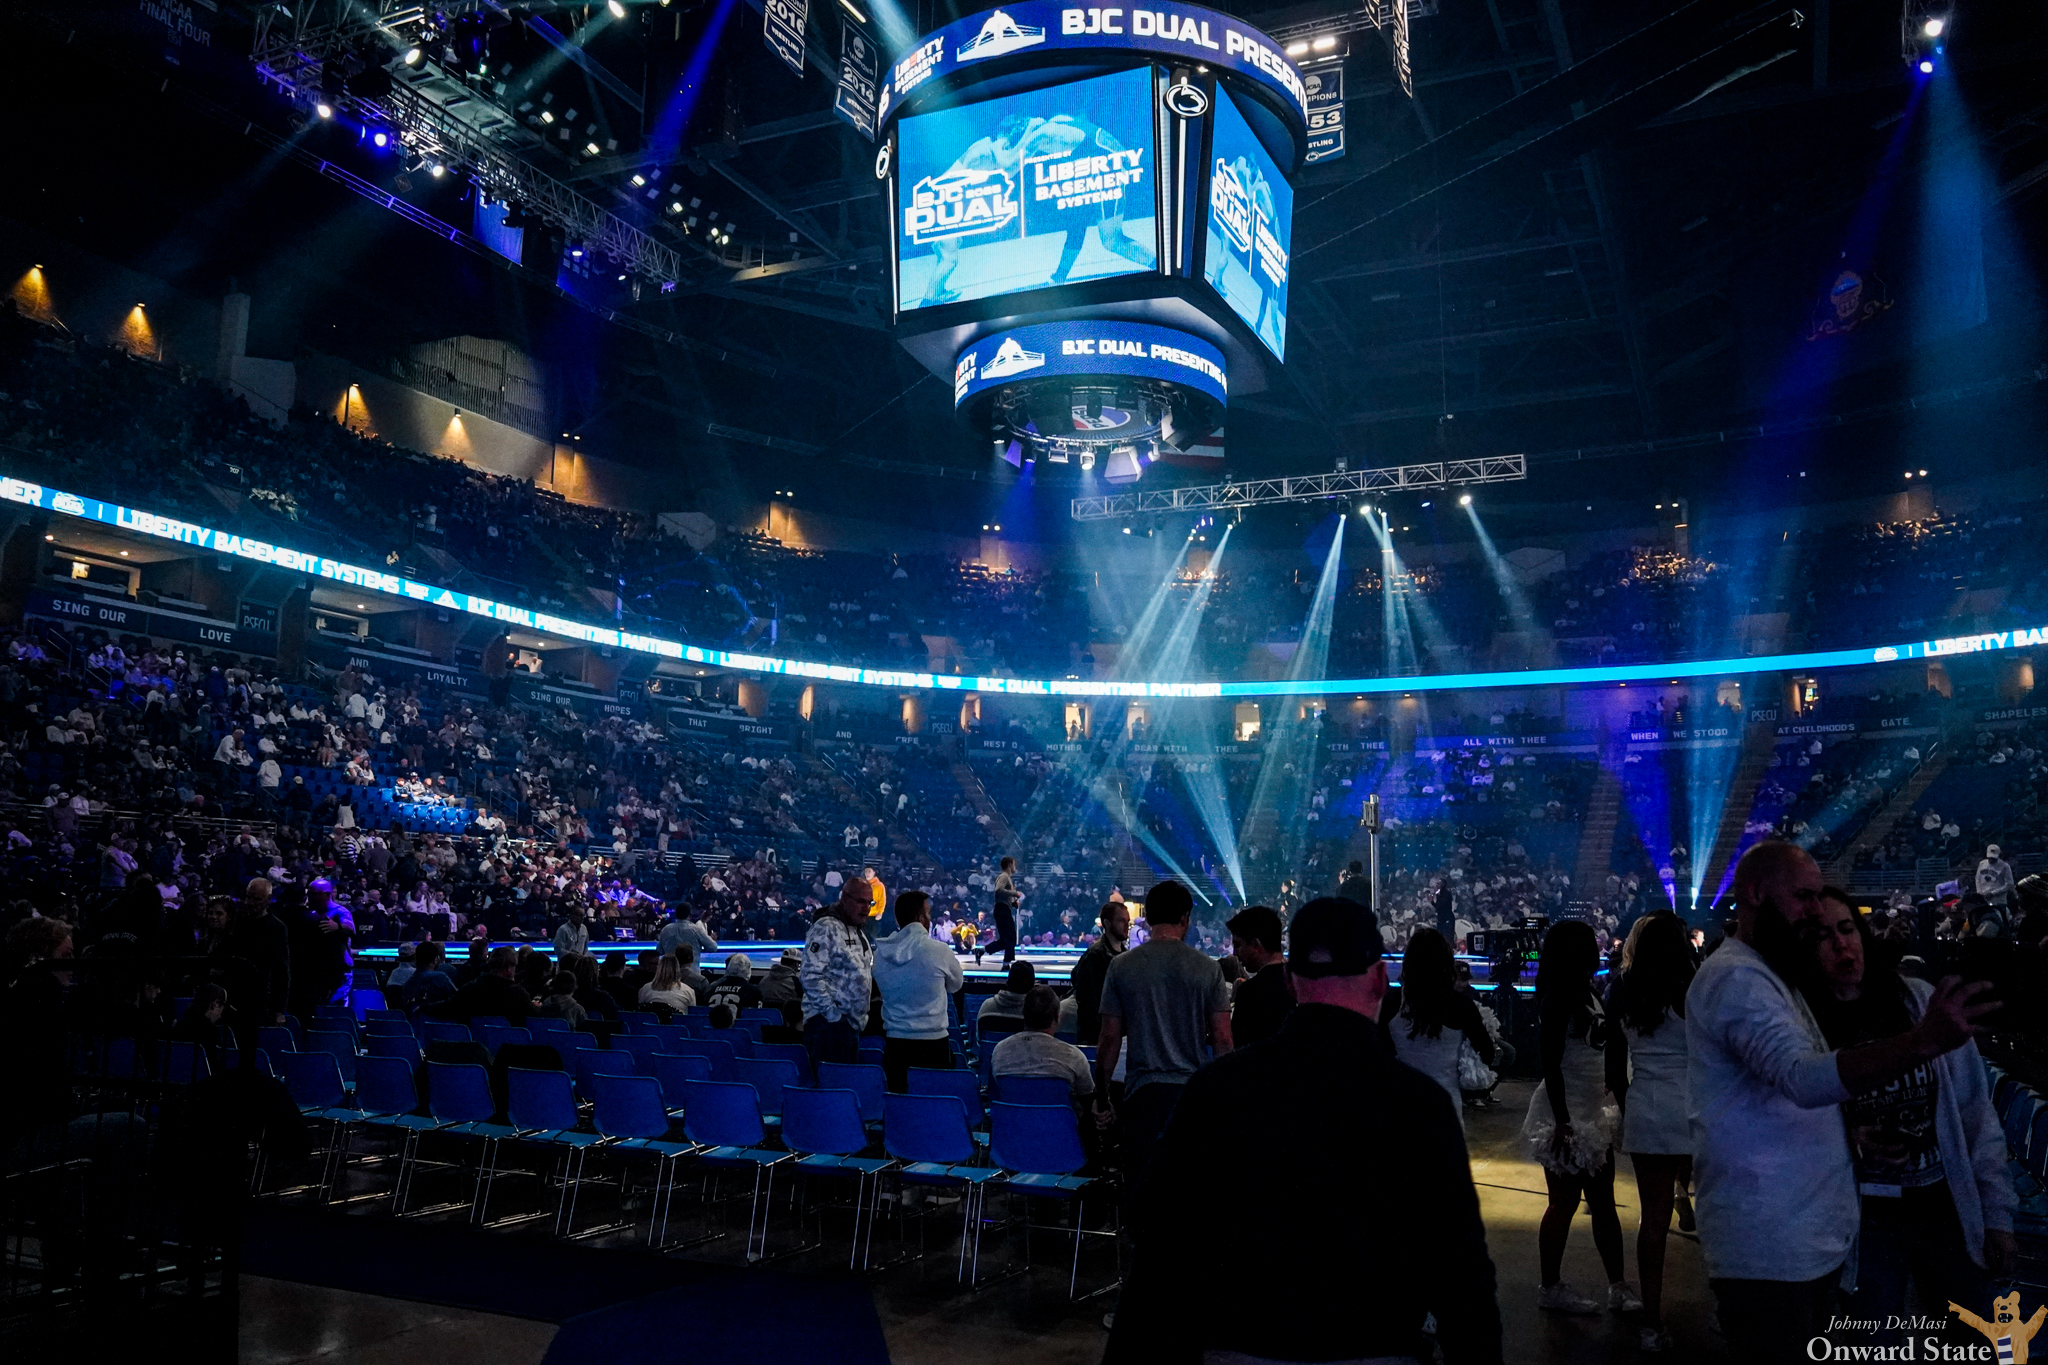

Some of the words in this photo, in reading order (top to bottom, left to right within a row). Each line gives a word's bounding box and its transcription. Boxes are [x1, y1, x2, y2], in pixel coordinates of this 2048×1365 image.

[766, 0, 805, 37] 2016
[177, 17, 211, 47] FOUR
[1062, 8, 1123, 35] BJC
[1133, 9, 1220, 51] DUAL
[895, 35, 945, 82] LIBERTY
[1035, 147, 1144, 185] LIBERTY
[1035, 168, 1144, 202] BASEMENT
[917, 186, 964, 209] BJC
[1057, 187, 1123, 211] SYSTEMS
[908, 193, 1015, 232] DUAL
[1062, 339, 1096, 356] BJC
[1099, 339, 1148, 358] DUAL
[116, 505, 211, 548] LIBERTY
[213, 530, 319, 575] BASEMENT
[320, 558, 400, 594] SYSTEMS
[52, 599, 90, 617] SING
[99, 608, 127, 624] OUR
[467, 595, 493, 617] BJC
[495, 603, 533, 627] DUAL
[199, 628, 232, 644] LOVE
[1923, 631, 2009, 658] LIBERTY
[350, 656, 369, 669] AND
[1006, 679, 1048, 694] DUAL
[530, 691, 552, 703] SING
[687, 717, 708, 728] THAT
[1751, 709, 1777, 722] PSECU
[835, 730, 853, 739] AND
[1630, 731, 1660, 741] WHEN
[1672, 730, 1688, 739] WE
[1777, 726, 1789, 735] AT
[983, 740, 1007, 748] REST
[1045, 743, 1083, 752] MOTHER
[1360, 741, 1385, 750] THEE
[1462, 738, 1483, 747] ALL
[1488, 737, 1515, 746] WITH
[1520, 736, 1547, 745] THEE
